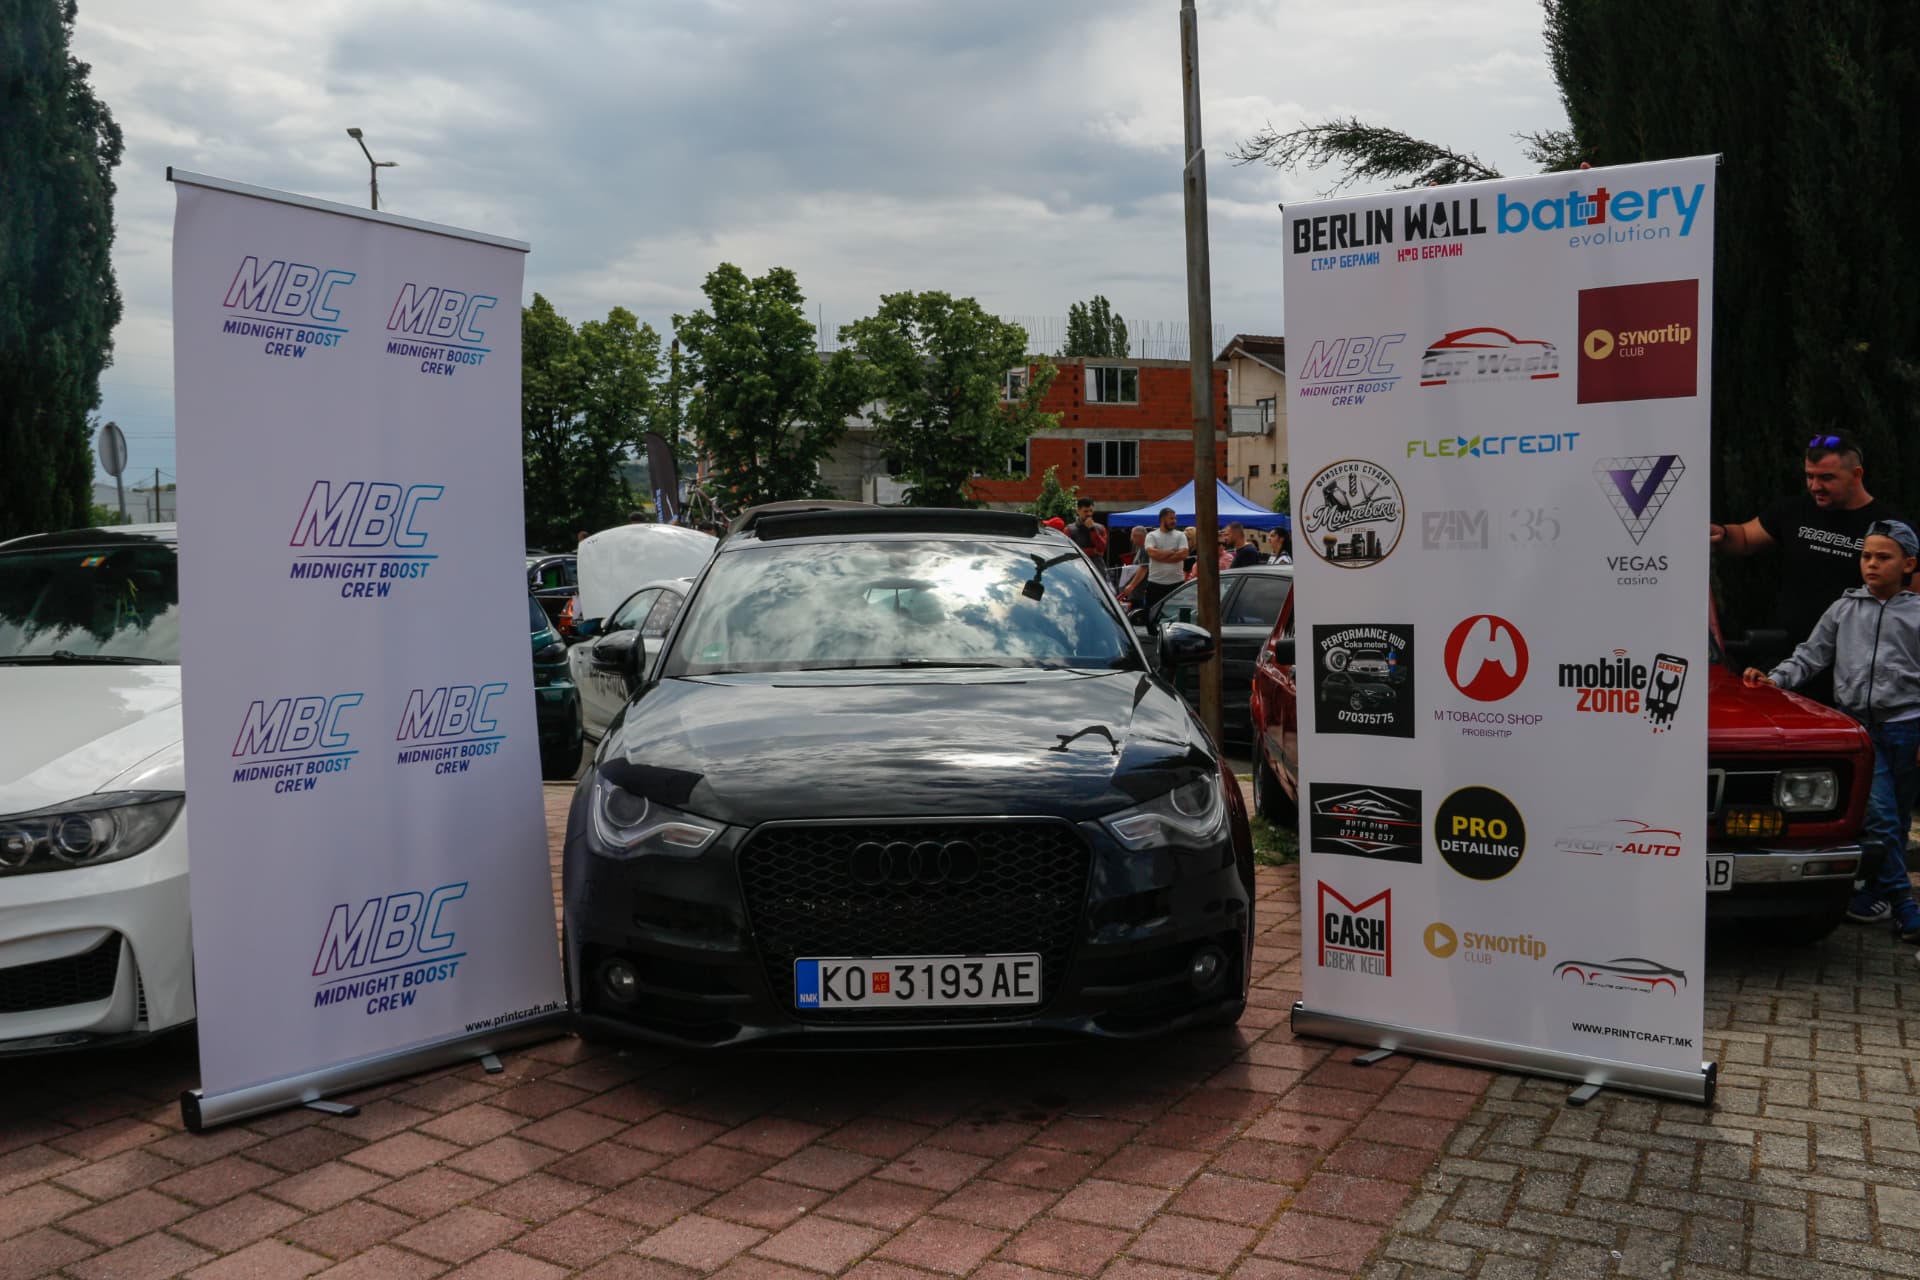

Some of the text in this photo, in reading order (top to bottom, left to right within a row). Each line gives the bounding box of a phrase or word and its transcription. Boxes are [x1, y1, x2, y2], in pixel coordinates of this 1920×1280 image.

[1497, 183, 1705, 237] battery
[1293, 198, 1487, 255] BERLIN WALL
[1569, 224, 1670, 248] evolution
[1339, 251, 1380, 269] БЕРЛИН
[1422, 243, 1463, 260] БЕРЛИН
[223, 255, 356, 322] MBC
[387, 283, 498, 342] MBC
[223, 320, 341, 347] MIDNIGHT BOOST
[264, 341, 306, 358] CREW
[386, 342, 485, 366] MIDNIGHT BOOST
[1299, 333, 1407, 379] MBC
[1619, 346, 1645, 358] CLUB
[420, 361, 455, 376] CREW
[1300, 381, 1395, 397] MIDNIGHT BOOST
[1331, 395, 1366, 407] CREW
[1362, 465, 1391, 486] СТУДИО
[289, 480, 445, 548] MBC
[290, 562, 430, 579] MIDNIGHT BOOST
[1606, 555, 1669, 571] VEGAS
[341, 582, 391, 598] CREW
[1616, 574, 1659, 585] casino
[1321, 628, 1406, 650] PERFORMANCE HUB
[1558, 657, 1647, 689] mobile
[1658, 661, 1683, 673] SERVICE
[397, 682, 508, 741] MBC
[1576, 688, 1640, 714] zone
[232, 693, 364, 757] MBC
[1338, 710, 1394, 724] 070375775
[1434, 710, 1543, 725] M TOBACCO SHOP
[1462, 728, 1513, 738] PROBISHTIP
[397, 742, 499, 765] MIDNIGHT BOOST
[233, 757, 351, 783] MIDNIGHT BOOST
[435, 760, 470, 775] CREW
[274, 777, 317, 794] CREW
[1452, 815, 1509, 840] PRO
[1440, 839, 1520, 858] DETAILING
[1554, 837, 1681, 857] PROFI-AUTO
[311, 881, 469, 976] MBC
[1324, 912, 1385, 951] CASH
[1325, 950, 1385, 975] СВЕЖ КЕШ
[1464, 951, 1492, 965] CLUB
[314, 961, 459, 1008] MIDNIGHT BOOST
[822, 961, 1034, 1002] KO 3193 AE
[366, 990, 417, 1015] CREW
[800, 993, 818, 1003] NMK
[465, 1000, 560, 1033] www.printcraft.mk
[1572, 1022, 1693, 1048] WWW.PRINTCRAFT.MK
